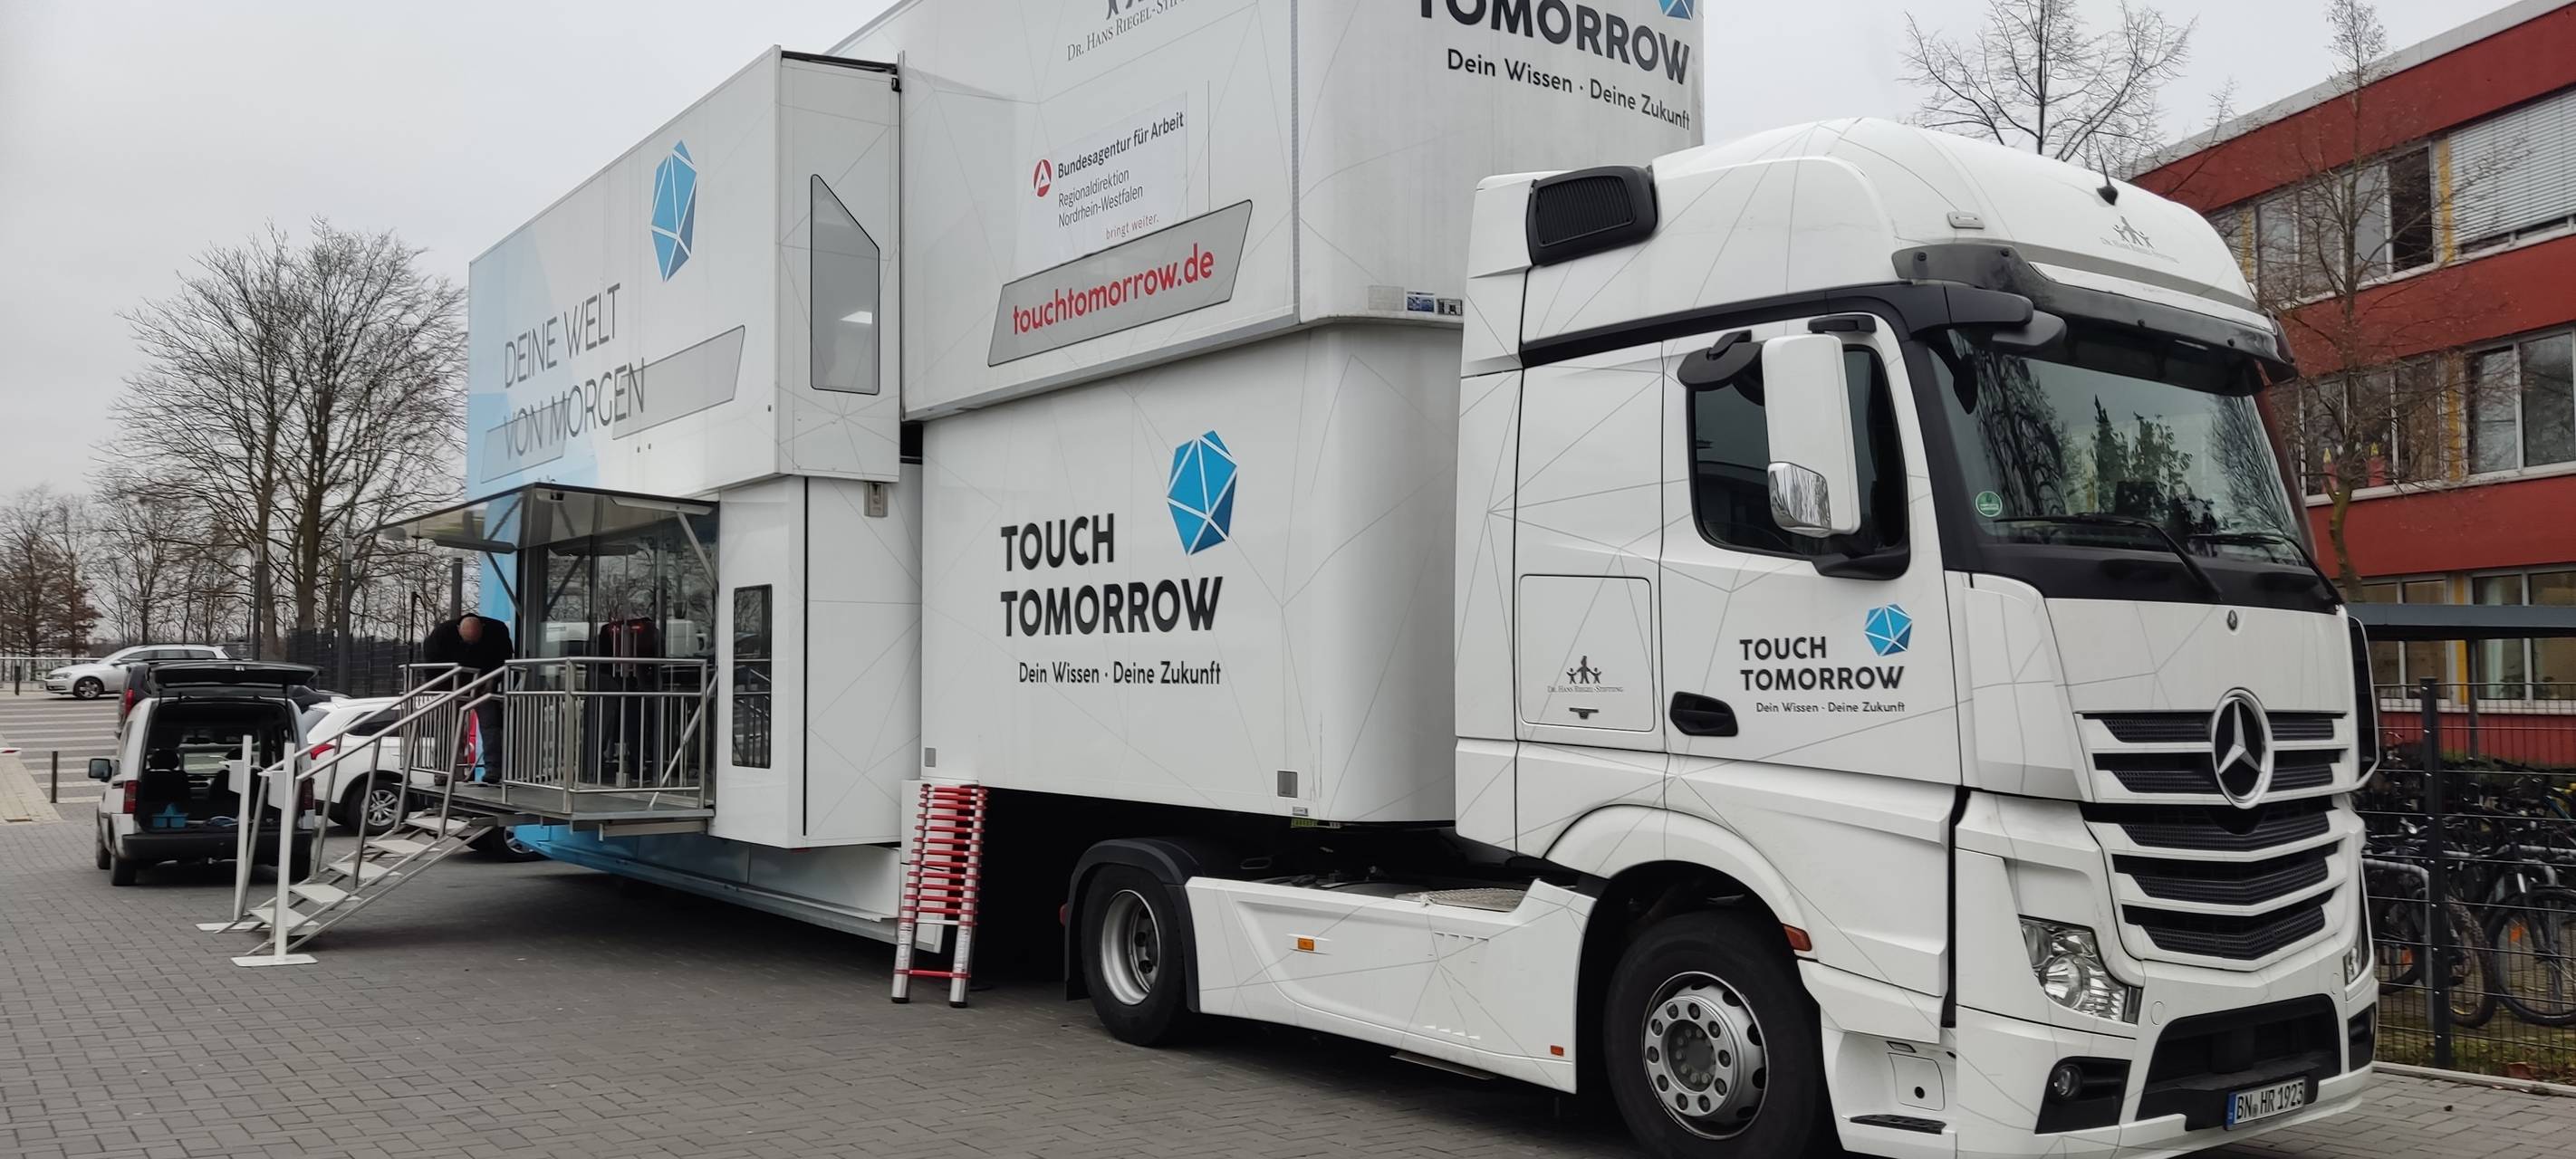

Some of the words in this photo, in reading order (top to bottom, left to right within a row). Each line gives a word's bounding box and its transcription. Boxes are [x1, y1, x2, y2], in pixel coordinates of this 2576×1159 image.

[1447, 48, 1496, 77] Dein
[1504, 58, 1572, 93] Wissen
[1590, 78, 1636, 110] Deine
[1641, 93, 1690, 130] Zukunft
[1058, 137, 1131, 179] Bundesagentur
[1133, 129, 1149, 147] für
[1151, 111, 1184, 140] Arbeit
[1058, 169, 1129, 208] Regionaldirektion
[1058, 185, 1143, 227] Nordrhein-Westfalen
[1106, 223, 1129, 240] bringt
[1132, 214, 1159, 231] weiter.
[1014, 243, 1214, 335] touchtomorrow.de
[505, 316, 557, 388] DEINE
[563, 283, 620, 359] WELT
[504, 399, 543, 460] VON
[550, 357, 645, 446] MORGEN
[1001, 512, 1114, 571] TOUCH
[1001, 576, 1223, 637] TOMORROW
[1739, 637, 1827, 661] TOUCH
[1019, 662, 1047, 684] Dein
[1052, 662, 1100, 684] Wissen
[1113, 661, 1155, 684] Deine
[1160, 661, 1221, 685] Zukunft
[1740, 666, 1905, 691] TOMORROW
[1756, 702, 1779, 713] Dein
[1782, 702, 1819, 713] Wissen
[1828, 702, 1859, 713] Deine
[1862, 701, 1906, 713] Zukunft
[2236, 1094, 2253, 1119] BN
[2261, 1089, 2274, 1114] HR
[2277, 1082, 2303, 1110] 1923
